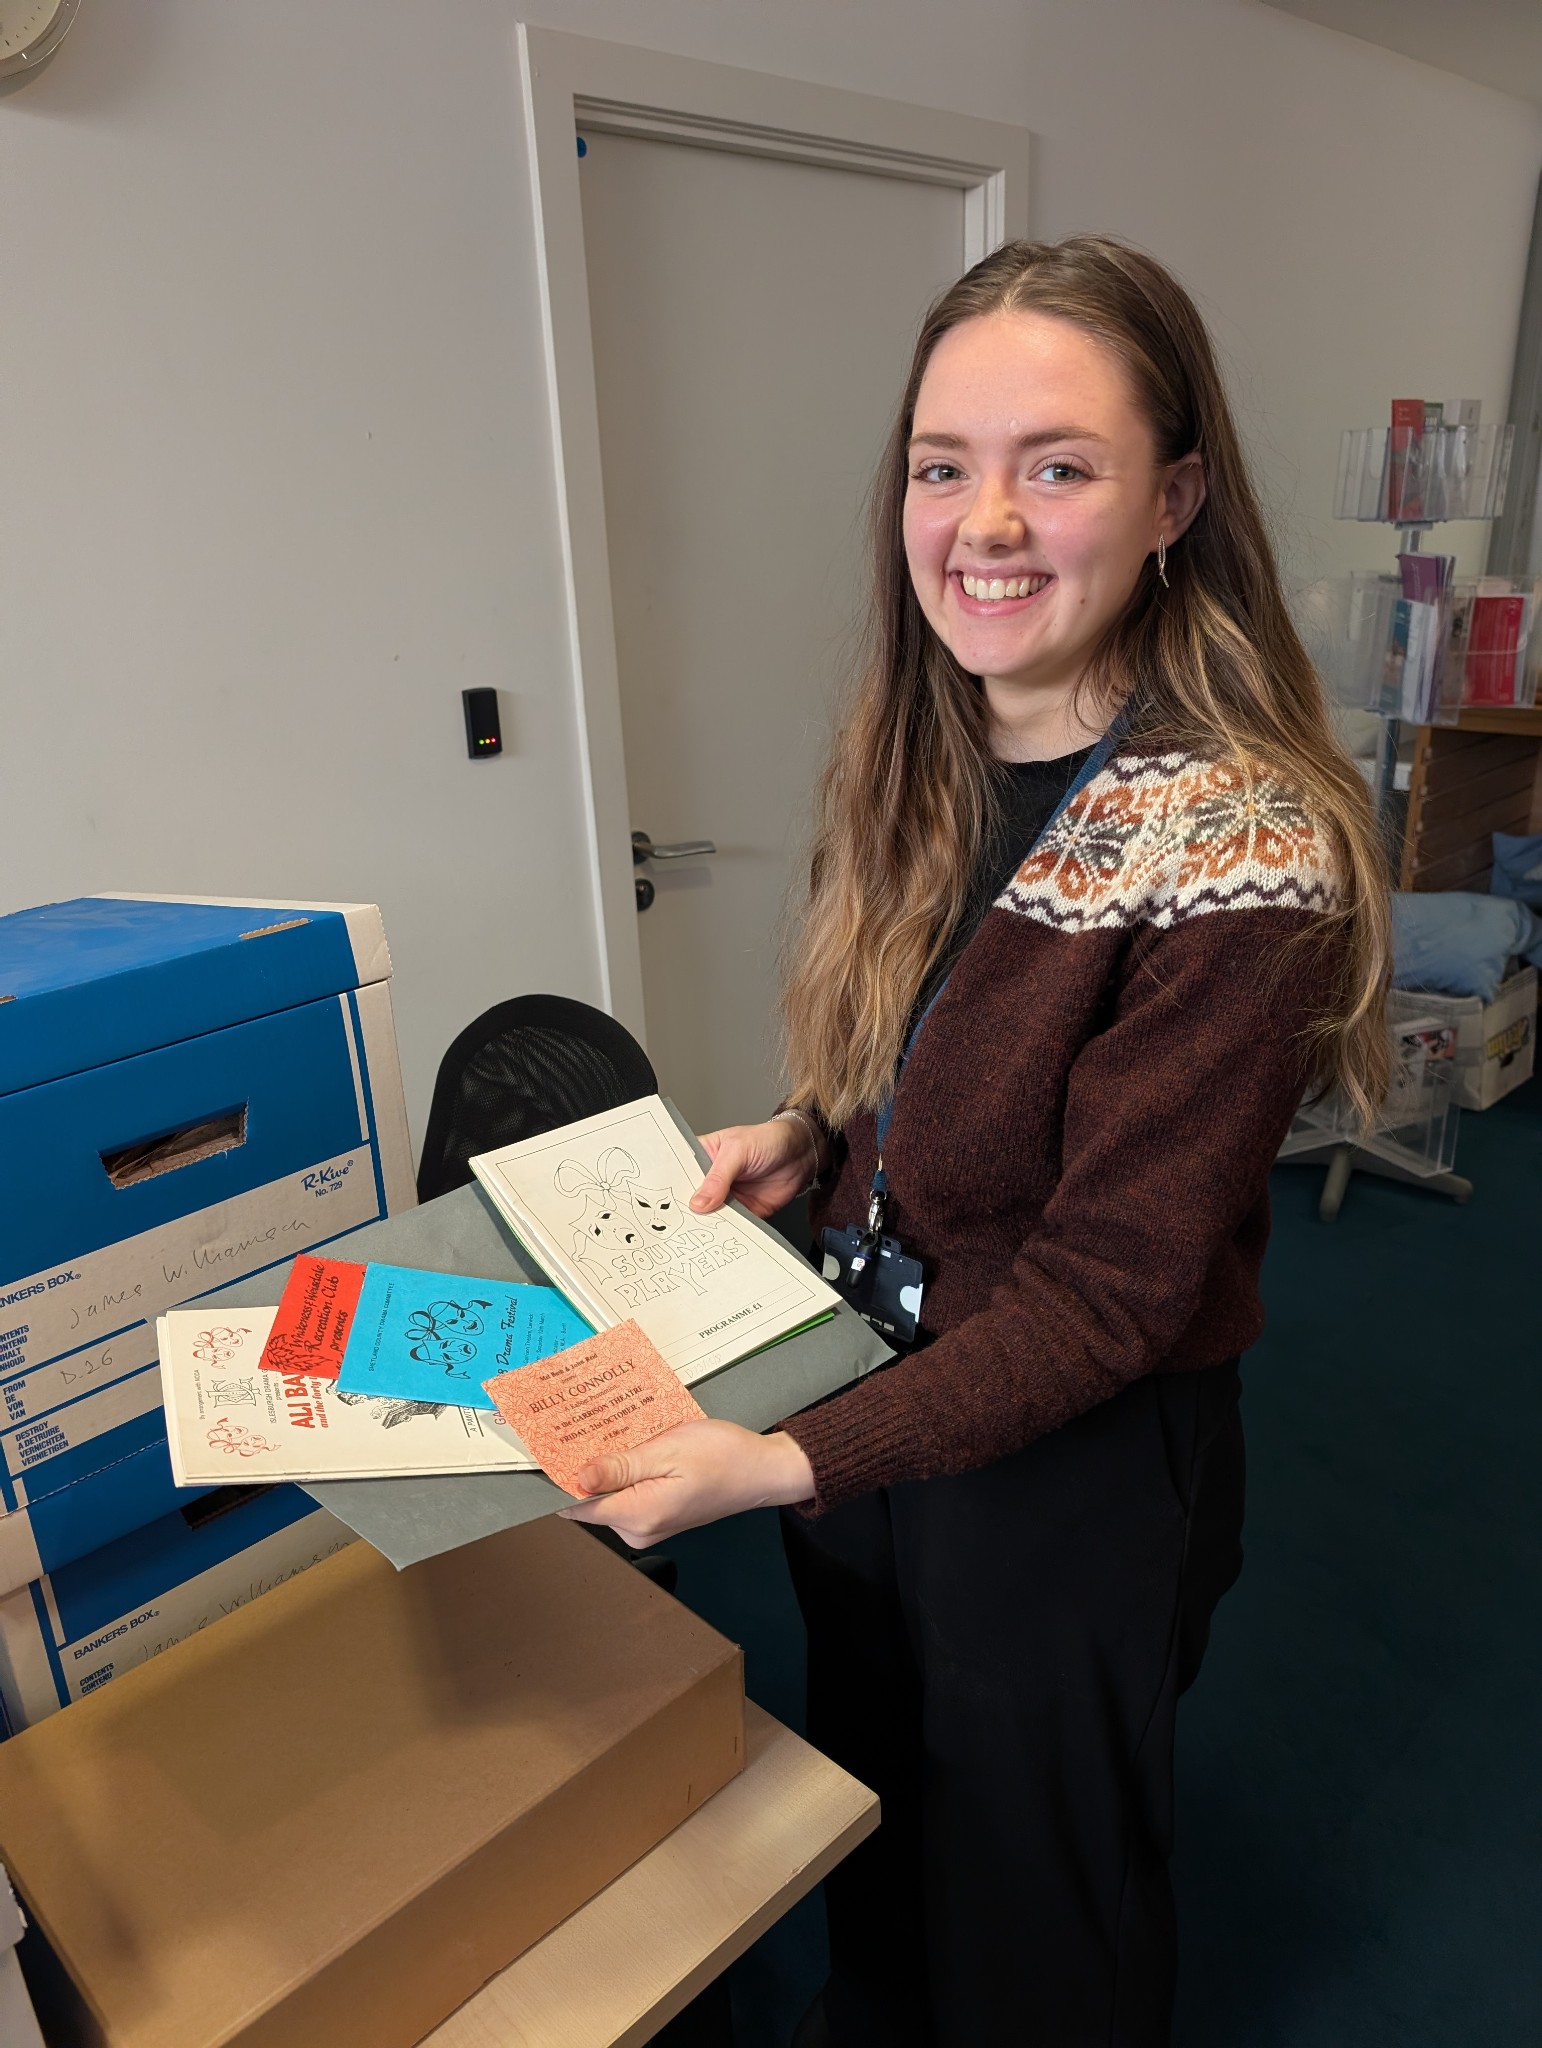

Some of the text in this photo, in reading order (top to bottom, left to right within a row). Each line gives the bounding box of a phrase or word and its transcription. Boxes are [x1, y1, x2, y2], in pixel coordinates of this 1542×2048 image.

[315, 1181, 343, 1197] No. 729
[611, 1229, 715, 1278] SOUND
[614, 1237, 749, 1309] PLAYERS
[0, 1283, 45, 1308] NKERS
[70, 1284, 142, 1330] James
[303, 1275, 340, 1353] Recreation Club
[500, 1294, 518, 1331] Festival
[699, 1302, 763, 1339] PROGRAMME £1
[0, 1324, 30, 1343] NTENTS
[329, 1309, 349, 1353] presents
[0, 1335, 28, 1353] ONTENU
[495, 1334, 514, 1365] Drama
[0, 1355, 26, 1372] NHOUD
[3, 1380, 26, 1396] FROM
[262, 1374, 272, 1393] DRAMA
[310, 1381, 323, 1400] forty
[529, 1358, 636, 1414] BILLY CONNOLLY
[5, 1393, 16, 1404] DE
[7, 1400, 24, 1413] VON
[265, 1393, 277, 1424] ISLESBURGH
[282, 1374, 316, 1429] ALI BA
[314, 1400, 325, 1413] the
[572, 1403, 610, 1424] GARRISON
[609, 1385, 645, 1407] THEATRE
[9, 1409, 26, 1421] VAN
[315, 1413, 329, 1428] and
[15, 1421, 49, 1442] DESTROY
[24, 1425, 61, 1447] DETRUIRE
[19, 1432, 65, 1459] VERNICHTEN
[21, 1439, 70, 1467] VERNIETIGEN
[73, 1624, 129, 1660] BANKERS
[80, 1662, 115, 1687] CONTENTS
[81, 1671, 113, 1694] CONTENU
